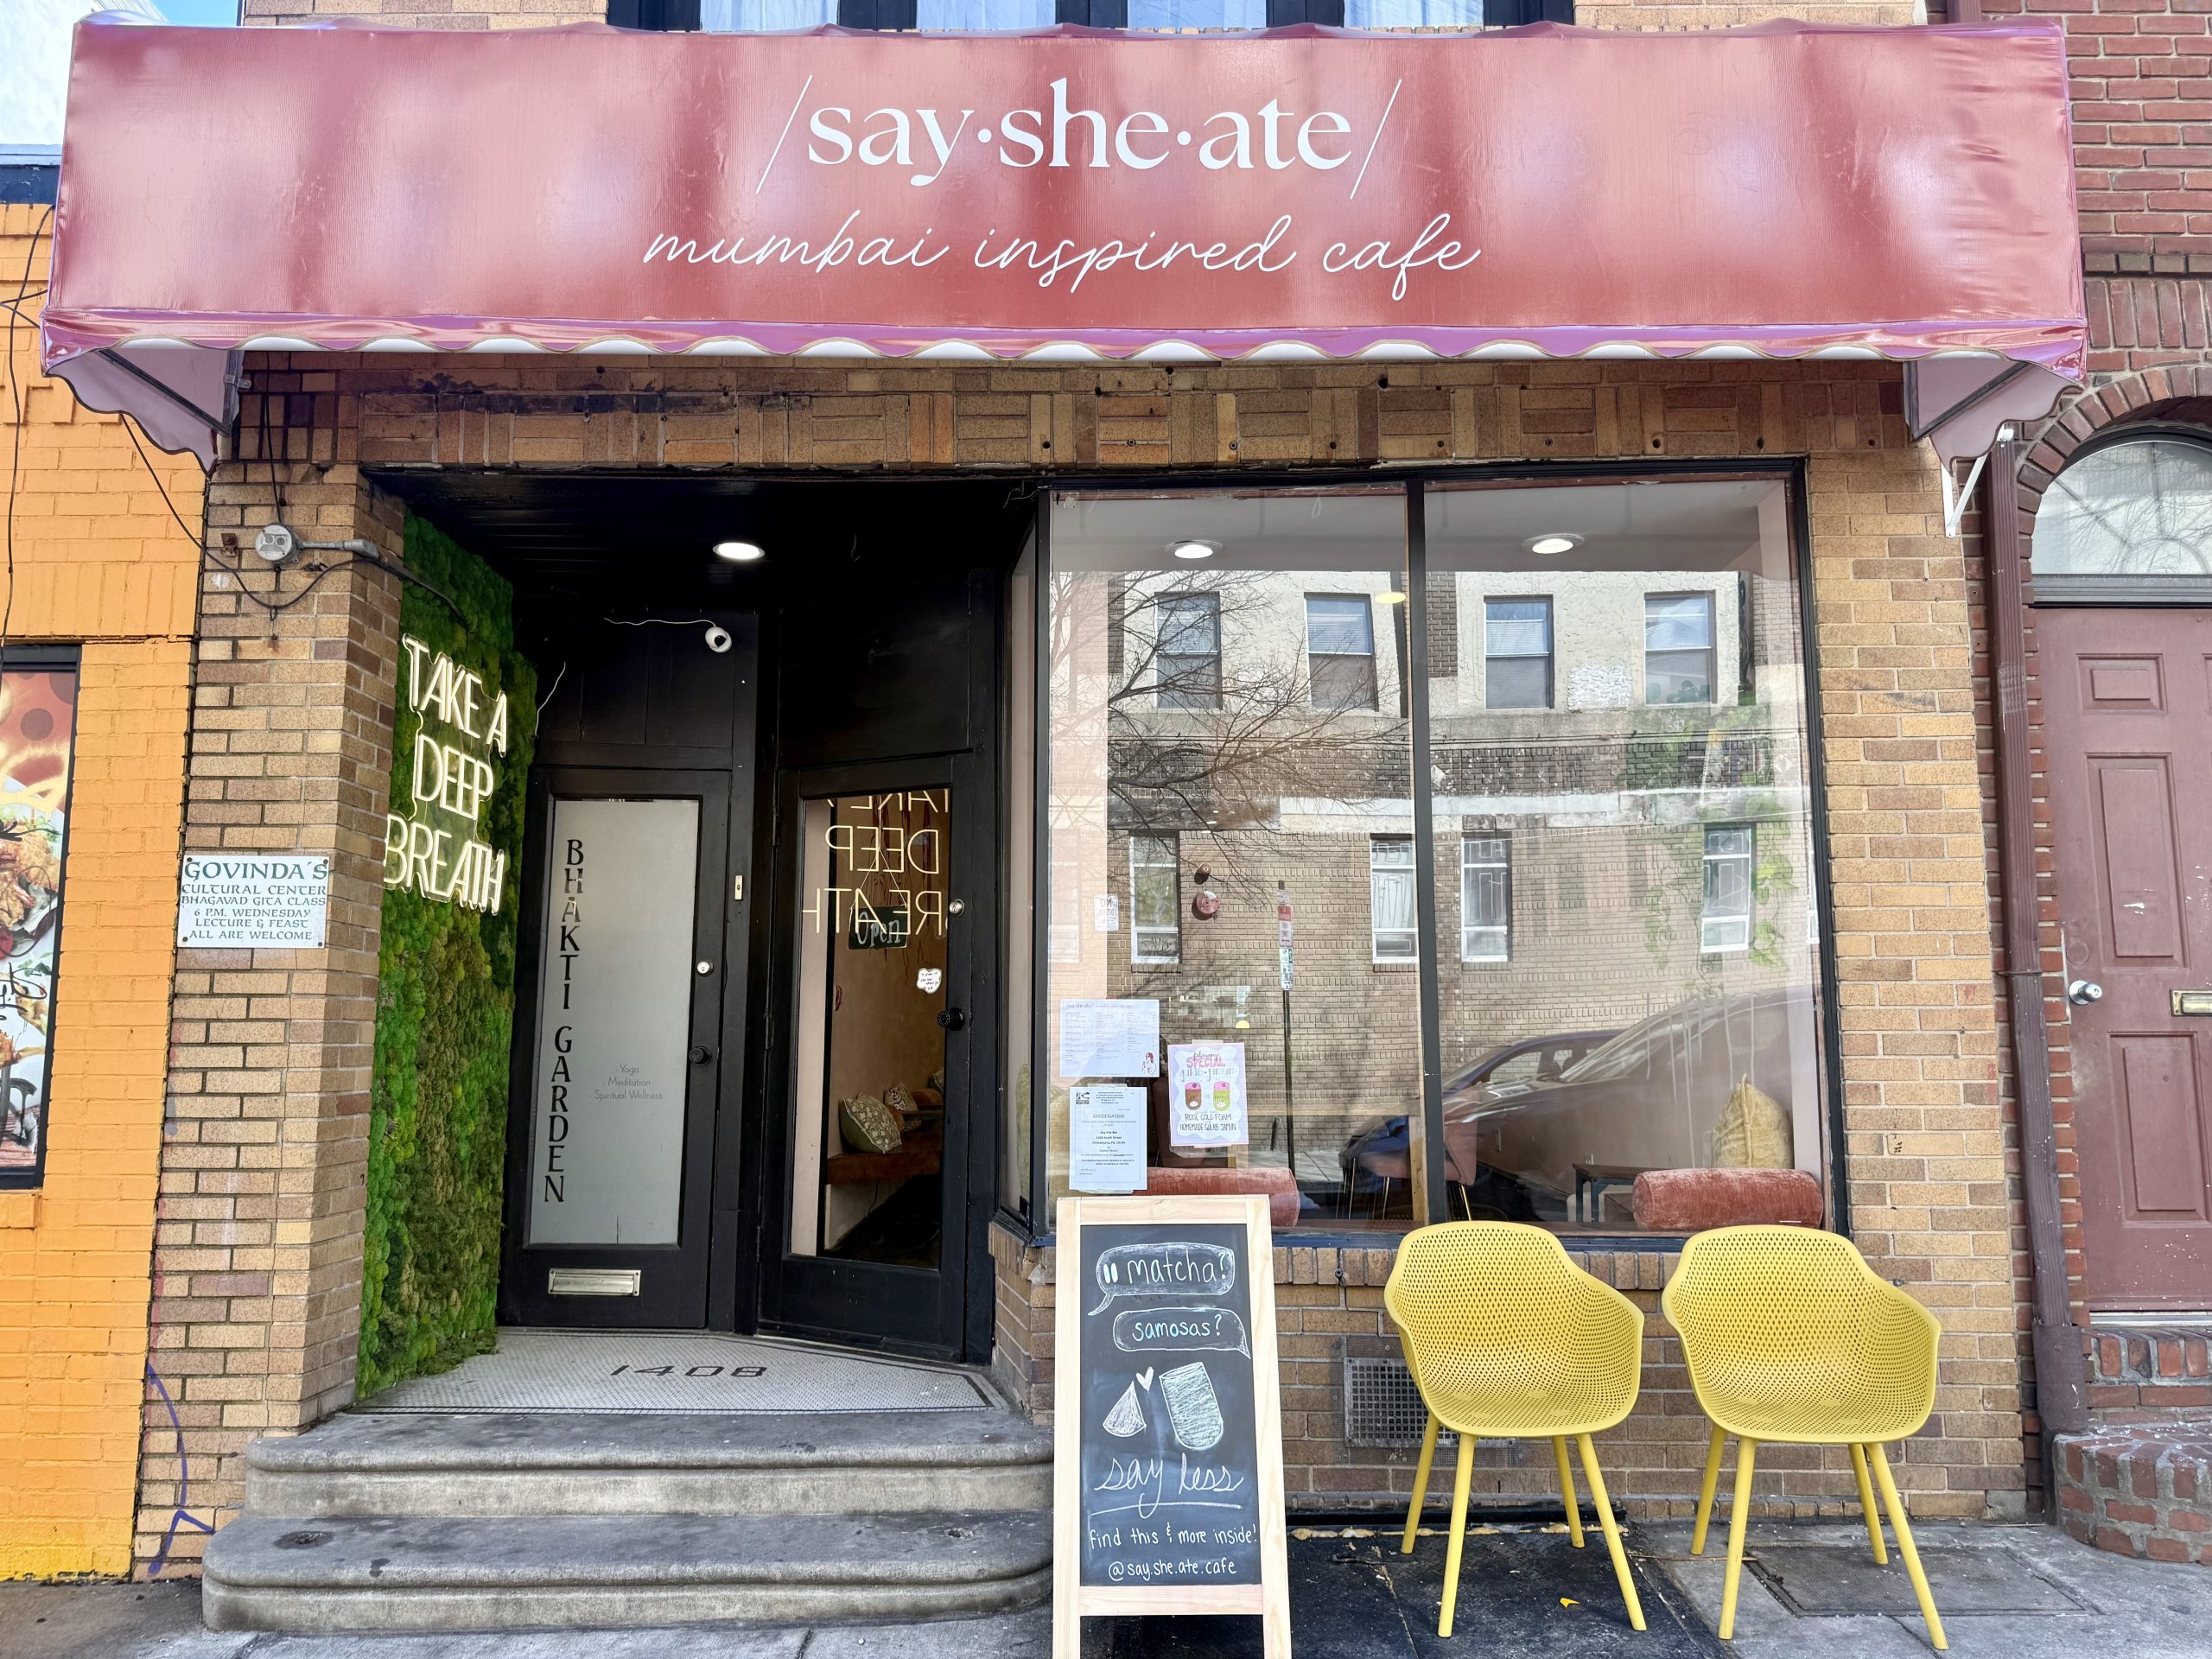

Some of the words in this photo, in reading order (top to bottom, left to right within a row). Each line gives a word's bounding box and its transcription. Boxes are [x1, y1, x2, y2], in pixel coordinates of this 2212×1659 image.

[642, 209, 950, 274] mumbai
[974, 214, 1297, 294] inspired
[1321, 213, 1483, 302] cafe
[404, 636, 482, 740] TAKE
[486, 692, 507, 754] A
[415, 733, 494, 821] DEEP
[382, 813, 505, 913] BREATH
[181, 883, 261, 895] CULTURAL
[268, 885, 327, 896] CENTER
[181, 895, 248, 906] BHAGAVAD
[253, 896, 282, 906] GITA
[287, 897, 326, 906] CLASS
[194, 908, 200, 917] 6
[206, 908, 226, 918] P.M.
[232, 908, 311, 918] WEDNESDAY
[195, 918, 251, 927] LECTURE
[257, 918, 264, 929] &
[269, 919, 308, 928] FEAST
[559, 838, 584, 1010] BHAKTI
[856, 911, 901, 948] Open
[189, 930, 213, 938] ALL
[219, 931, 244, 939] ARE
[246, 931, 312, 940] WELCOME
[619, 1064, 639, 1076] Yoga
[1186, 1056, 1226, 1069] SPECIAL
[607, 1077, 651, 1086] Meditation
[594, 1089, 626, 1101] Spiritual
[628, 1090, 664, 1099] Wellness
[543, 1025, 573, 1203] GARDEN
[1131, 1313, 1223, 1342] samosas?
[609, 1364, 767, 1378] 1408
[1093, 1457, 1163, 1519] say
[1178, 1452, 1244, 1495] less
[1130, 1527, 1159, 1545] this
[1178, 1529, 1207, 1544] more
[1212, 1523, 1257, 1545] inside!
